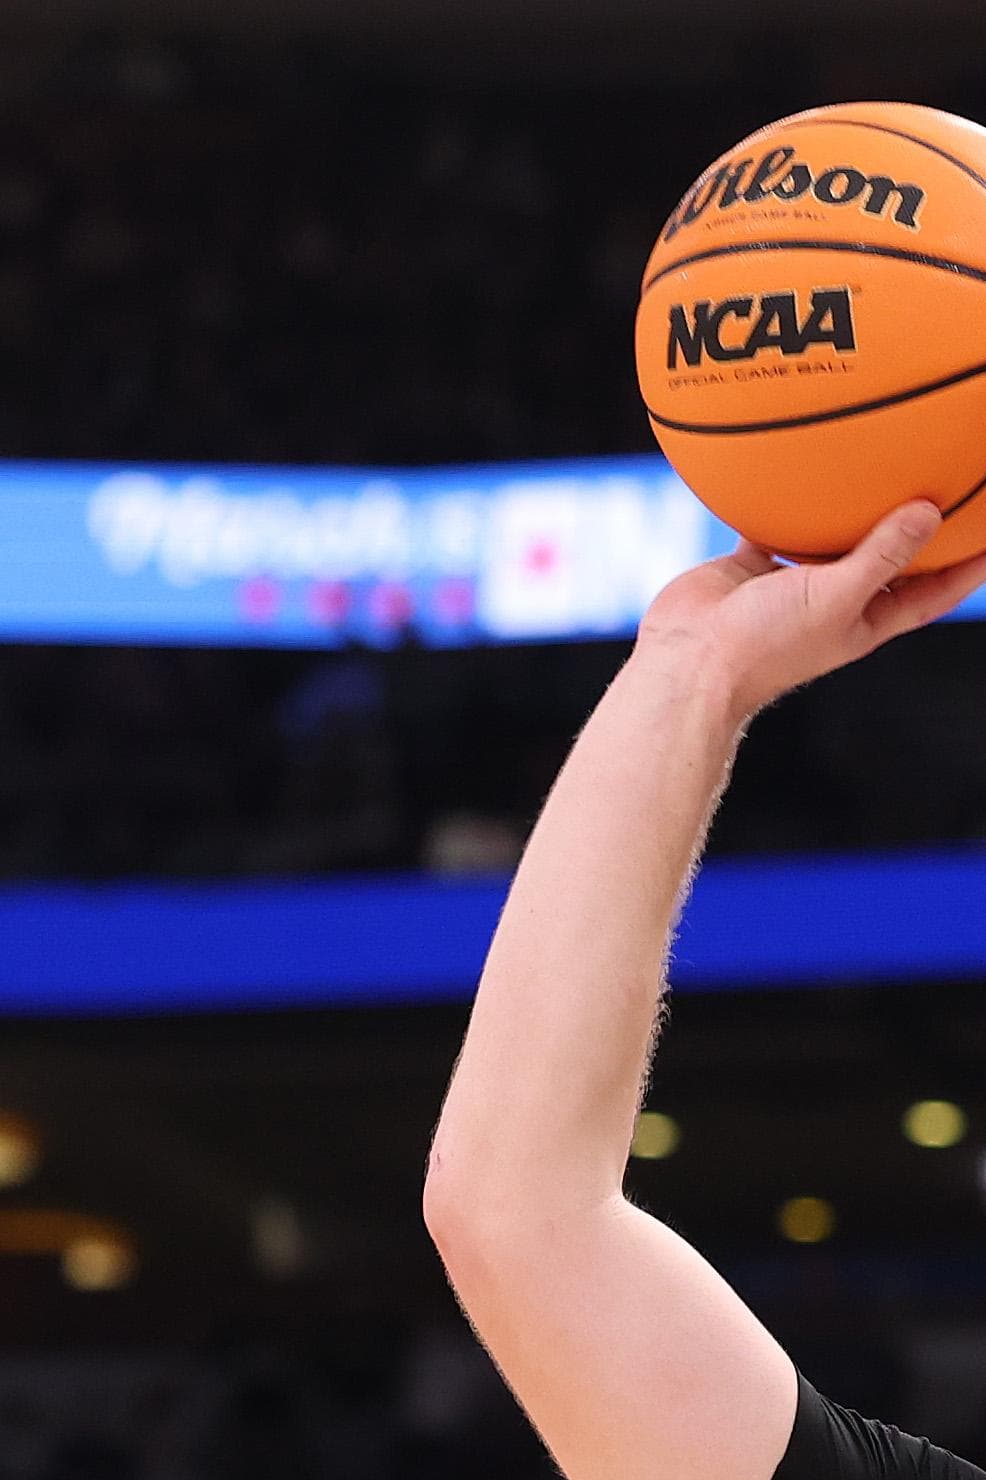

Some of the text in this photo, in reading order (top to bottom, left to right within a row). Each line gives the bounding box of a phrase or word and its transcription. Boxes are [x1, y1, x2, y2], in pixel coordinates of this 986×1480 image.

[664, 146, 924, 241] Wilson
[667, 288, 856, 370] NCAA
[734, 364, 790, 382] GAME
